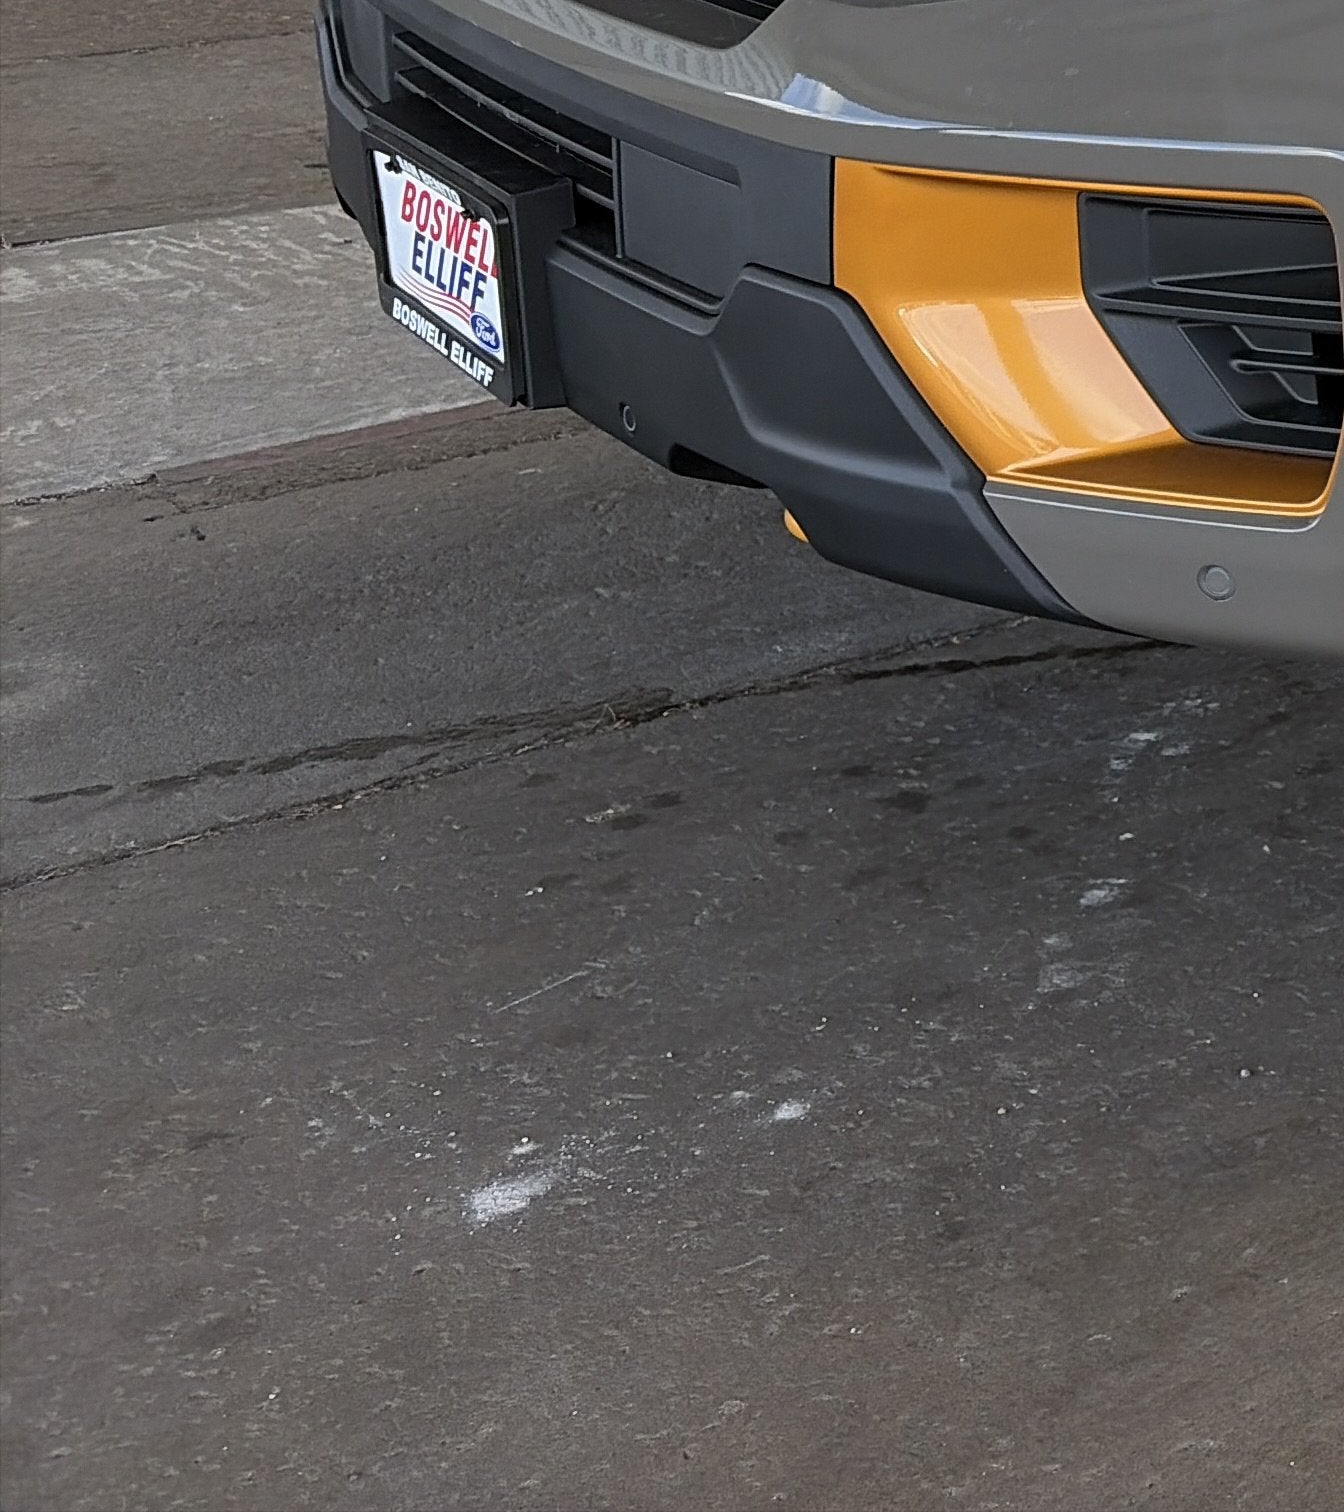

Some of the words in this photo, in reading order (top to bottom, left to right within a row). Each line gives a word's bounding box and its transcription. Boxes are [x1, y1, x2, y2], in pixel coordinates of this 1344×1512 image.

[411, 230, 488, 314] ELLIFF
[392, 296, 450, 358] BOSWELL
[449, 345, 495, 387] ELLIFF
